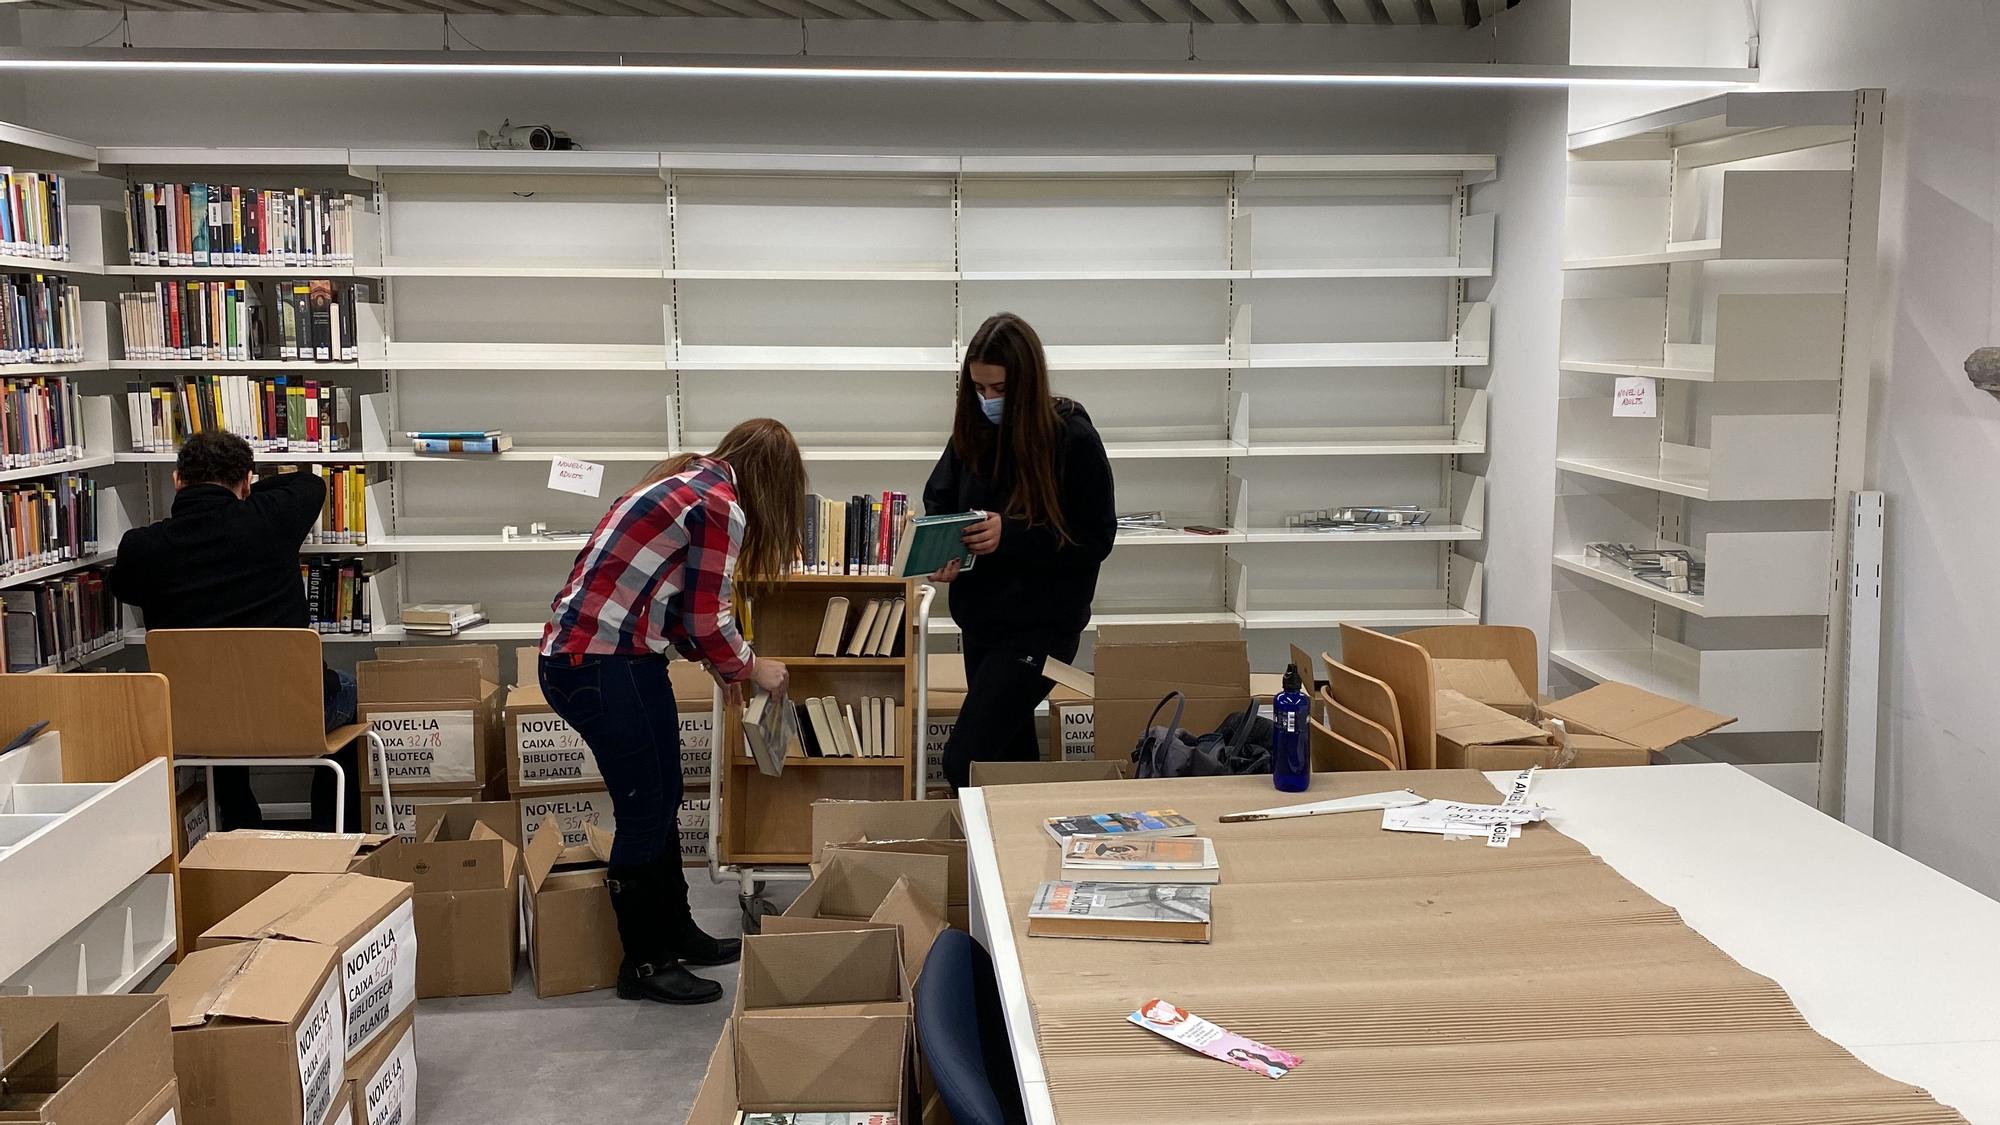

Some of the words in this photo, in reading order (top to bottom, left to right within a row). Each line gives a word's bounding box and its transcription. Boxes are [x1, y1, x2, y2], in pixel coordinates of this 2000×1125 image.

[372, 719, 439, 731] NOVEL·LA
[522, 739, 555, 749] CAIXA
[373, 752, 434, 761] BBLIOTECA
[523, 752, 585, 764] BIBLIOTECA
[389, 766, 430, 776] PLANTA
[524, 769, 536, 778] 1a
[540, 766, 581, 776] PLANTA
[526, 801, 593, 817] NOVEL·LA
[375, 821, 405, 831] CAXA
[347, 928, 395, 979] NOVEL·LA
[349, 974, 373, 1002] CAIXA
[349, 978, 393, 1020] BIBLIOTECA
[299, 1000, 329, 1059] NOVEL·LA
[348, 1032, 358, 1048] 1a
[359, 1003, 389, 1037] PLANTA
[304, 1053, 318, 1085] CAIXA
[306, 1057, 331, 1112] BIBLIOTECA
[369, 1056, 402, 1111] NOVEL·LA
